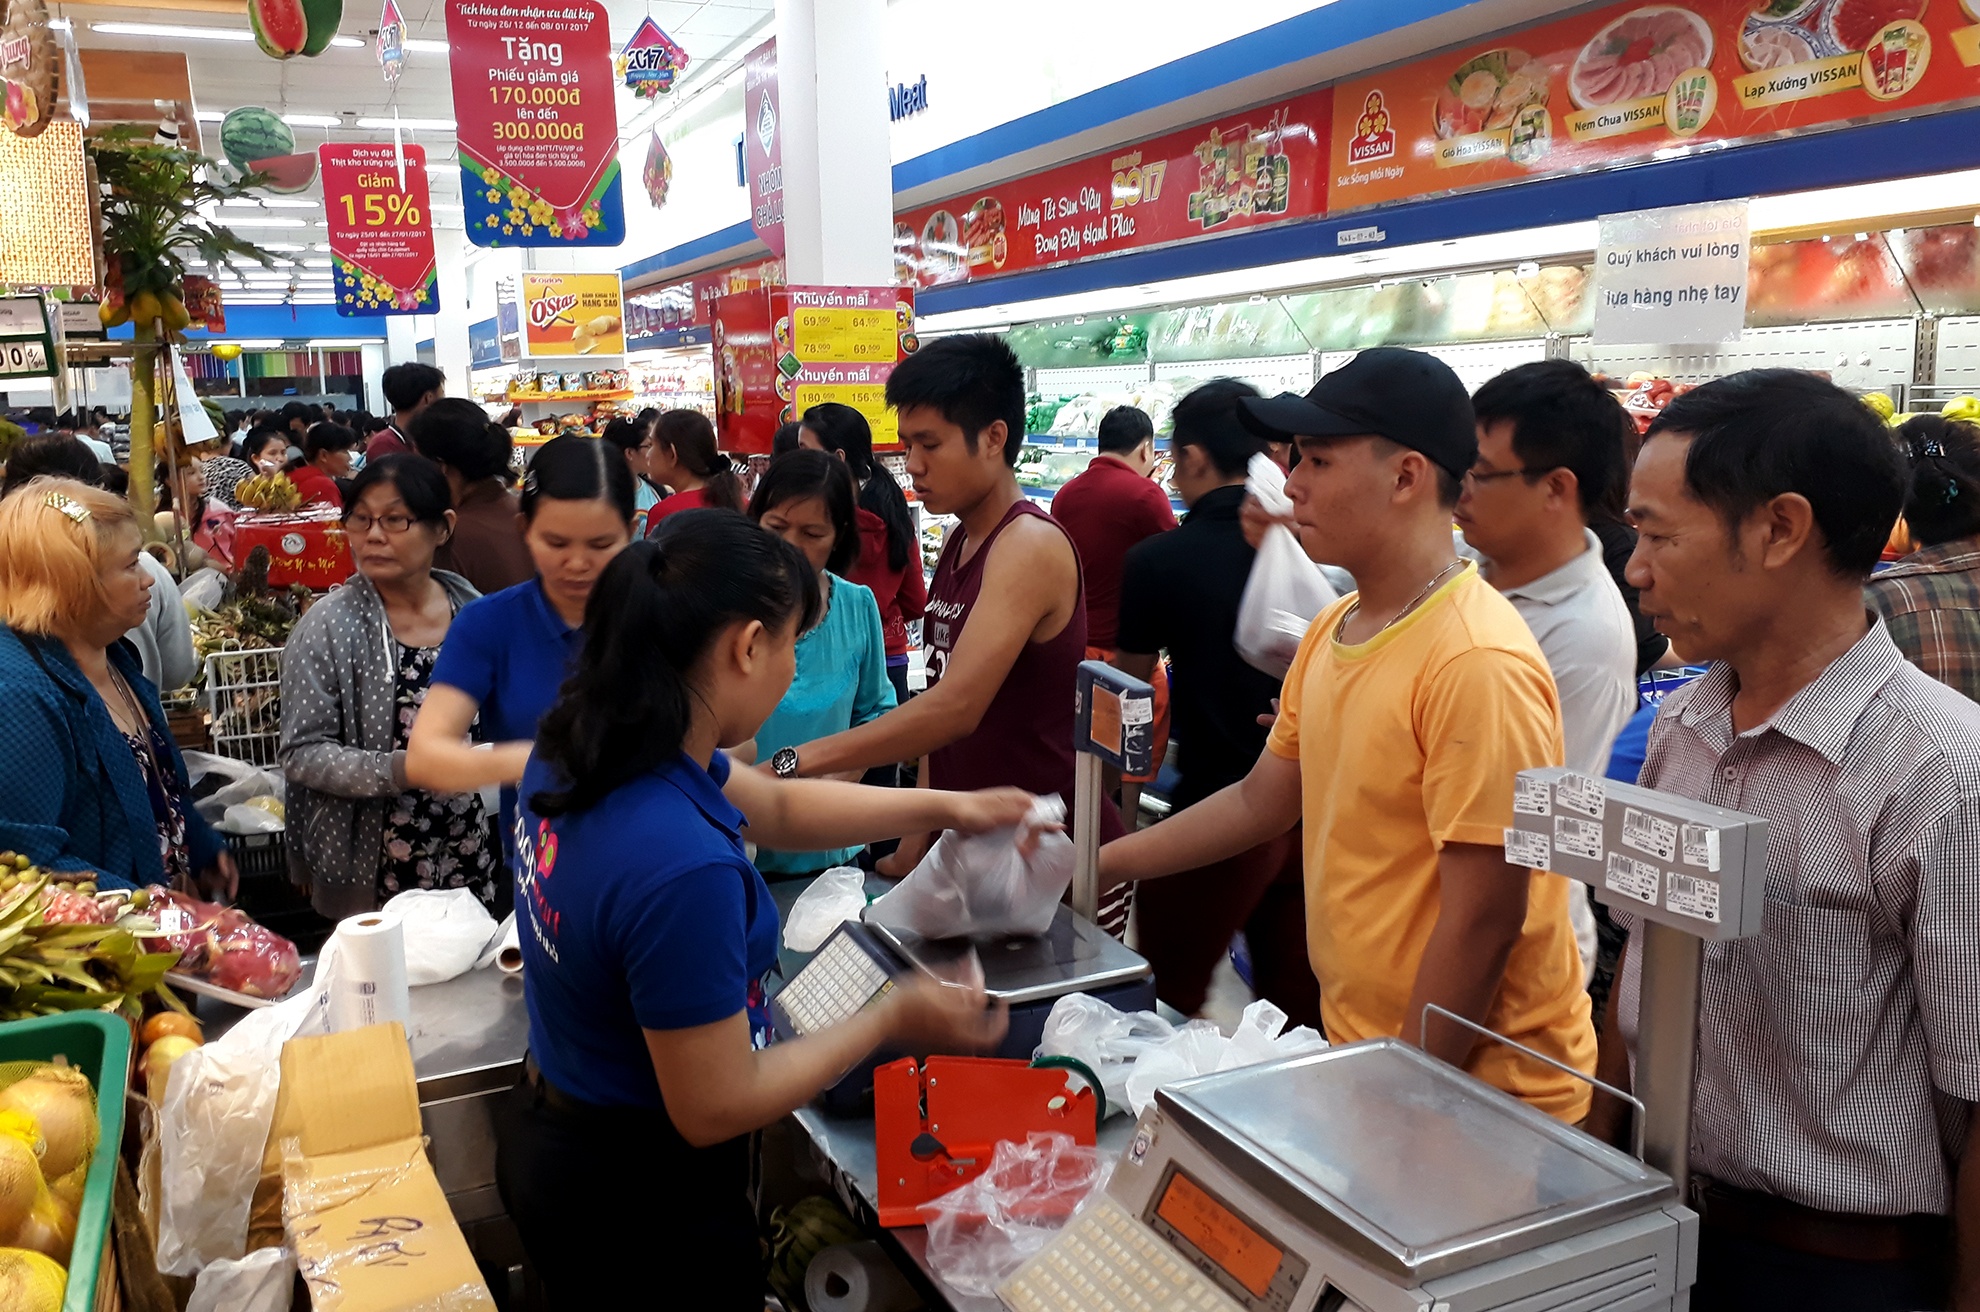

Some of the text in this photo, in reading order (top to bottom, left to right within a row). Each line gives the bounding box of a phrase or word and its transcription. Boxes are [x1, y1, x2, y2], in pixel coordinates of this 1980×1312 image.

[479, 3, 499, 16] hóa
[499, 4, 520, 17] đơn
[520, 5, 545, 19] nhận
[478, 20, 497, 30] ngày
[525, 20, 540, 30] đến
[500, 36, 563, 66] Tặng
[628, 48, 663, 70] 2017
[489, 67, 579, 86] Phiếu giảm giá
[1744, 63, 1858, 101] Lạp Xưởng VISSAN
[489, 86, 581, 106] 170.000đ
[516, 106, 558, 120] lên đến
[1574, 105, 1661, 132] Nem Chua VISSAN
[492, 121, 584, 140] 300.000đ
[352, 149, 394, 159] Dịch vụ đặt
[1353, 140, 1390, 158] VISSAN
[331, 158, 346, 167] Thịt
[1384, 165, 1405, 178] Ngày
[357, 171, 395, 188] Giảm
[1110, 160, 1168, 211] 2017
[340, 193, 421, 226] 15%
[1607, 242, 1739, 267] Quý khách vui lòng
[603, 299, 618, 307] SAO
[793, 290, 843, 308] Khuyến
[1606, 284, 1741, 308] lựa hàng nhẹ tay
[796, 367, 870, 384] Khuyến mãi
